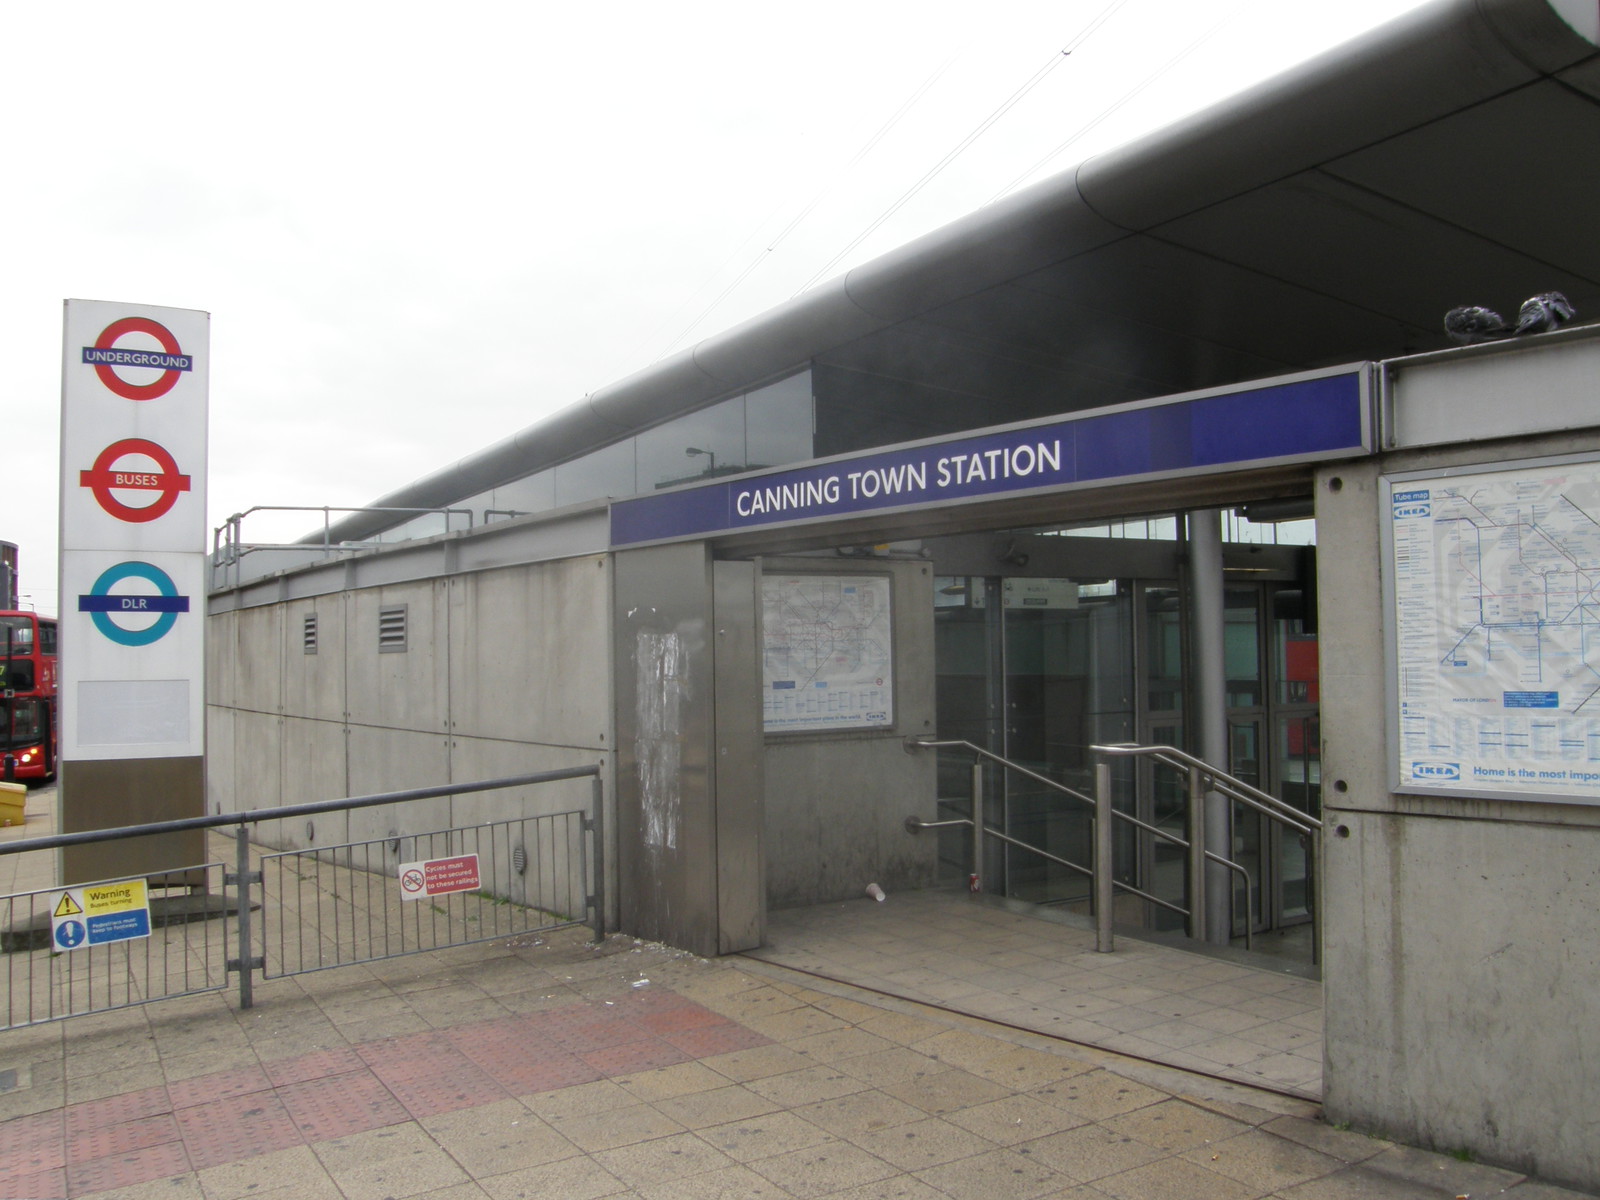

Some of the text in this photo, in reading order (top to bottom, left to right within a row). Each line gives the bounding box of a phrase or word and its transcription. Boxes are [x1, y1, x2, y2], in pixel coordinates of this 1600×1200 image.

[86, 350, 188, 368] UNDERGROUND
[115, 474, 158, 486] BUSES
[737, 440, 1061, 516] CANNING TOWN STATION
[1395, 492, 1428, 501] Tube map
[1398, 507, 1426, 516] IKEA
[121, 598, 148, 609] DLR
[1418, 766, 1455, 775] IKEA
[1473, 766, 1505, 776] Home
[1507, 767, 1516, 777] is
[1518, 768, 1536, 778] the
[1538, 769, 1566, 779] most
[425, 865, 446, 873] Cycles
[448, 869, 472, 878] secured
[455, 877, 478, 885] railings
[89, 889, 131, 901] Warning
